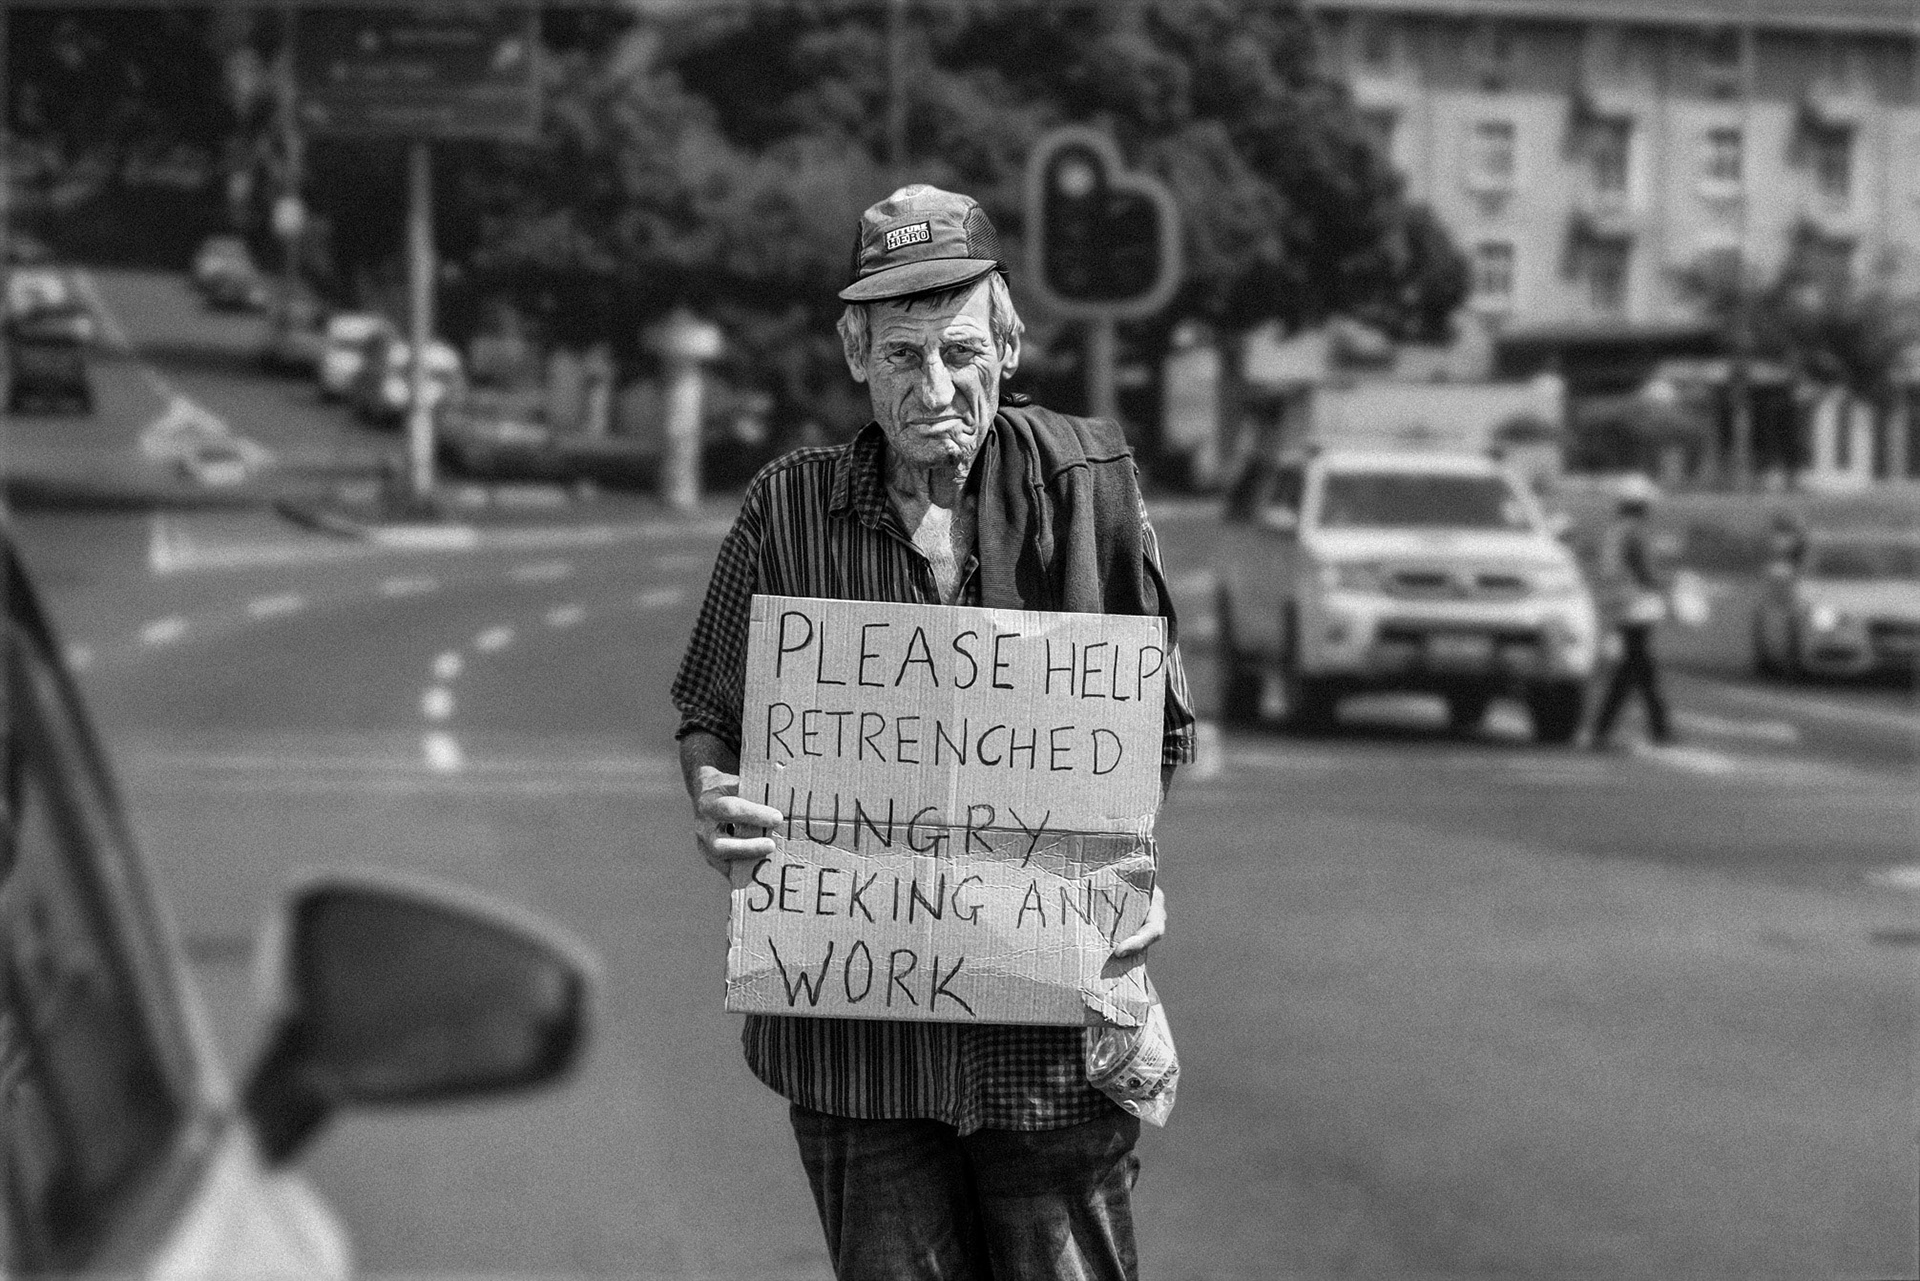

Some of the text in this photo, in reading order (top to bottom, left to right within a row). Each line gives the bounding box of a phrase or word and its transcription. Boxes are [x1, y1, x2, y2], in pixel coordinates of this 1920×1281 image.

[887, 230, 930, 250] HERO
[776, 611, 1164, 701] PLEASE HELP
[766, 702, 1123, 775] RETRENCHED
[763, 783, 1050, 868] HUNGRY
[747, 858, 1128, 948] SEEKING ANY
[768, 936, 977, 1018] WORK
